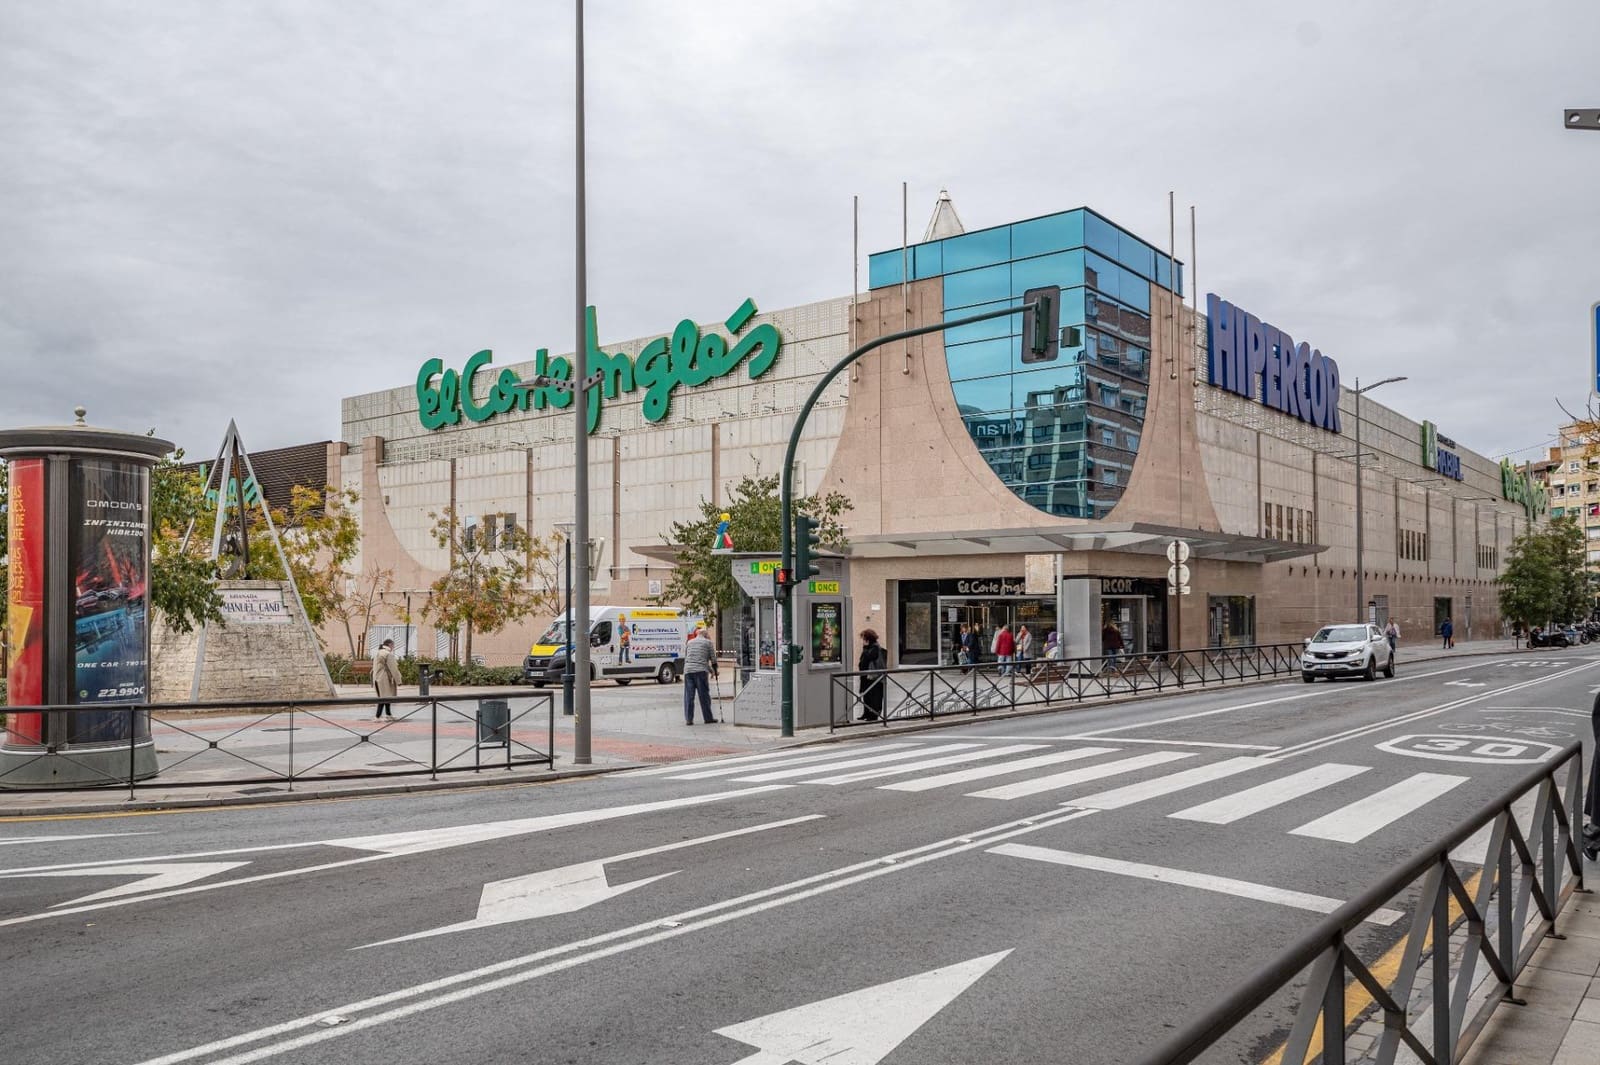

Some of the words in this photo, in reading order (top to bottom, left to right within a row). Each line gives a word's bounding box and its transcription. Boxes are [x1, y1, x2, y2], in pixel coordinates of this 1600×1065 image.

[416, 358, 461, 430] El
[461, 348, 573, 423] Corte
[584, 297, 782, 435] Inglés
[1206, 293, 1342, 433] HIPERCOR
[762, 563, 782, 572] ONC
[817, 583, 837, 592] ONCE
[957, 580, 970, 594] El
[971, 580, 999, 593] Corte
[999, 577, 1025, 597] Ingl
[1102, 578, 1132, 593] RCOR
[223, 602, 256, 613] MANUEL
[259, 602, 280, 612] CANO
[1412, 739, 1528, 757] 30
